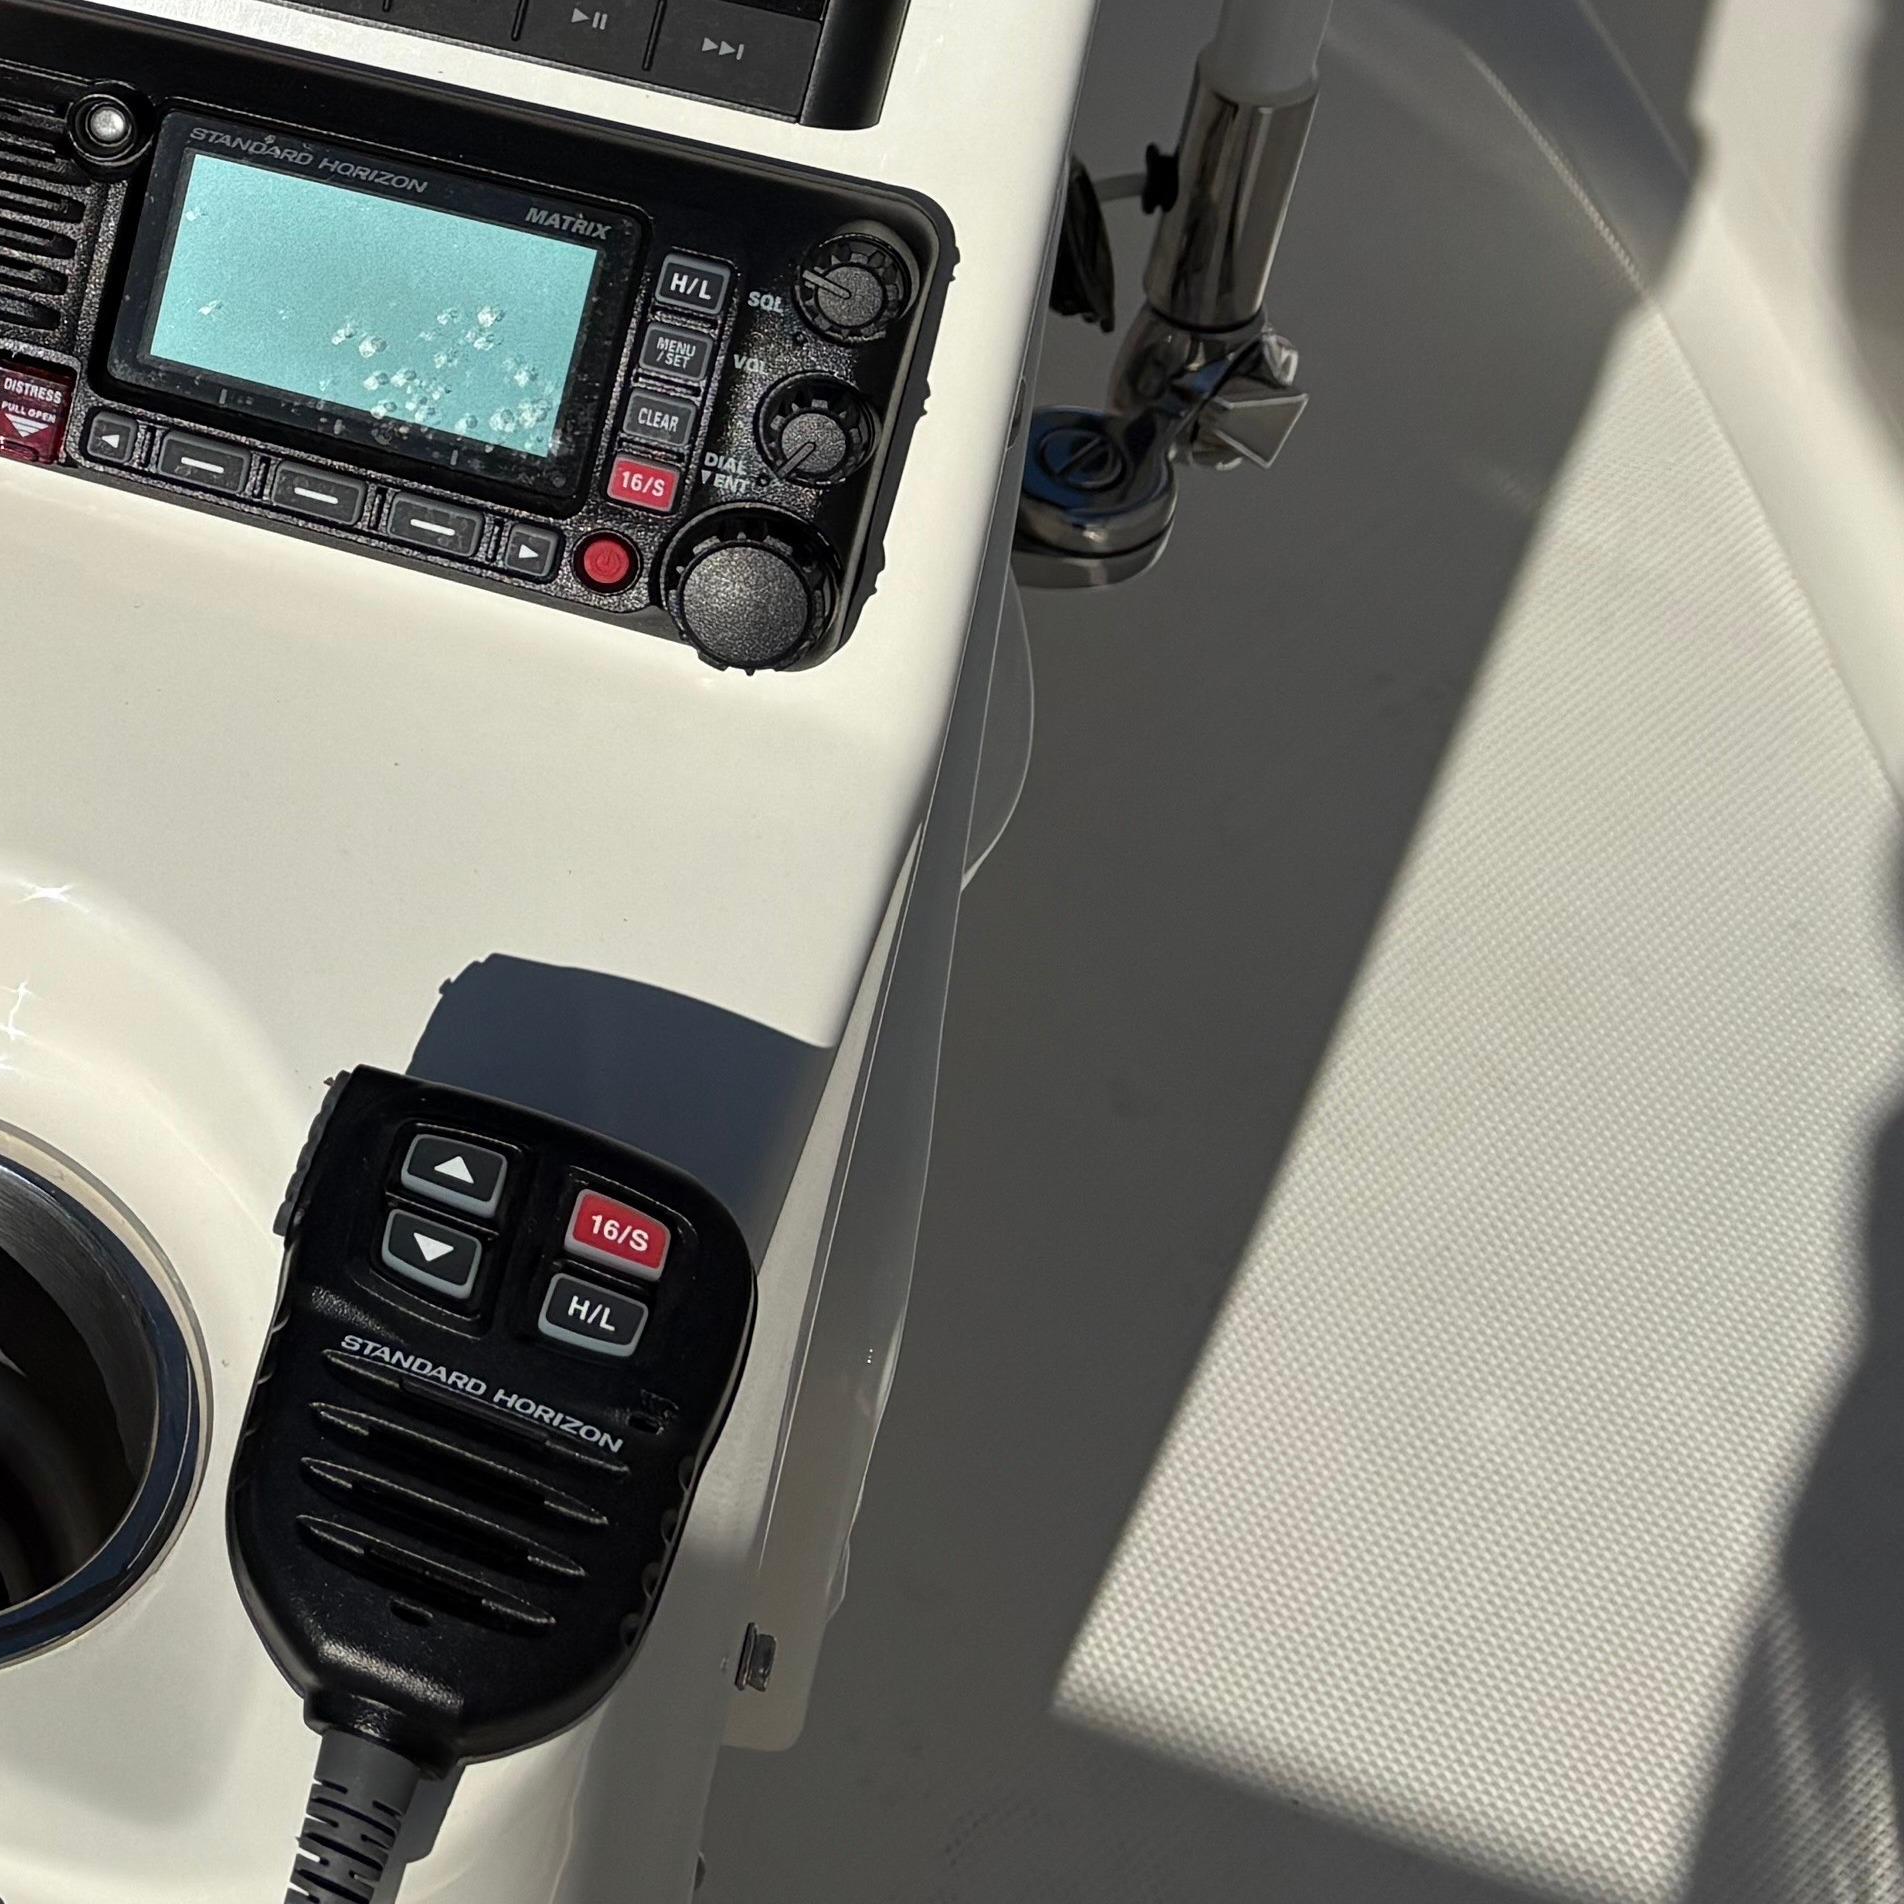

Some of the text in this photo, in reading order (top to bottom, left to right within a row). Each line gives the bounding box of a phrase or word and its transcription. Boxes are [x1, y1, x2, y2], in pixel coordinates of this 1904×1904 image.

[189, 126, 428, 194] STANDARD HORIZON
[525, 207, 612, 241] MATRIX
[670, 273, 713, 301] H/L
[747, 291, 785, 314] SQL
[655, 349, 692, 371] /SET
[656, 336, 697, 359] MENU
[733, 353, 768, 375] VOL
[3, 377, 63, 404] DISTRESS
[1, 400, 57, 424] PULL OPEN
[637, 407, 680, 433] CLEAR
[703, 451, 748, 475] DIAL
[620, 470, 666, 498] 16/S
[713, 473, 750, 494] ENT
[590, 1213, 651, 1253] 16/S
[566, 1296, 619, 1333] H/L
[340, 1333, 487, 1397] STANDARD
[493, 1387, 624, 1454] HORIZON
